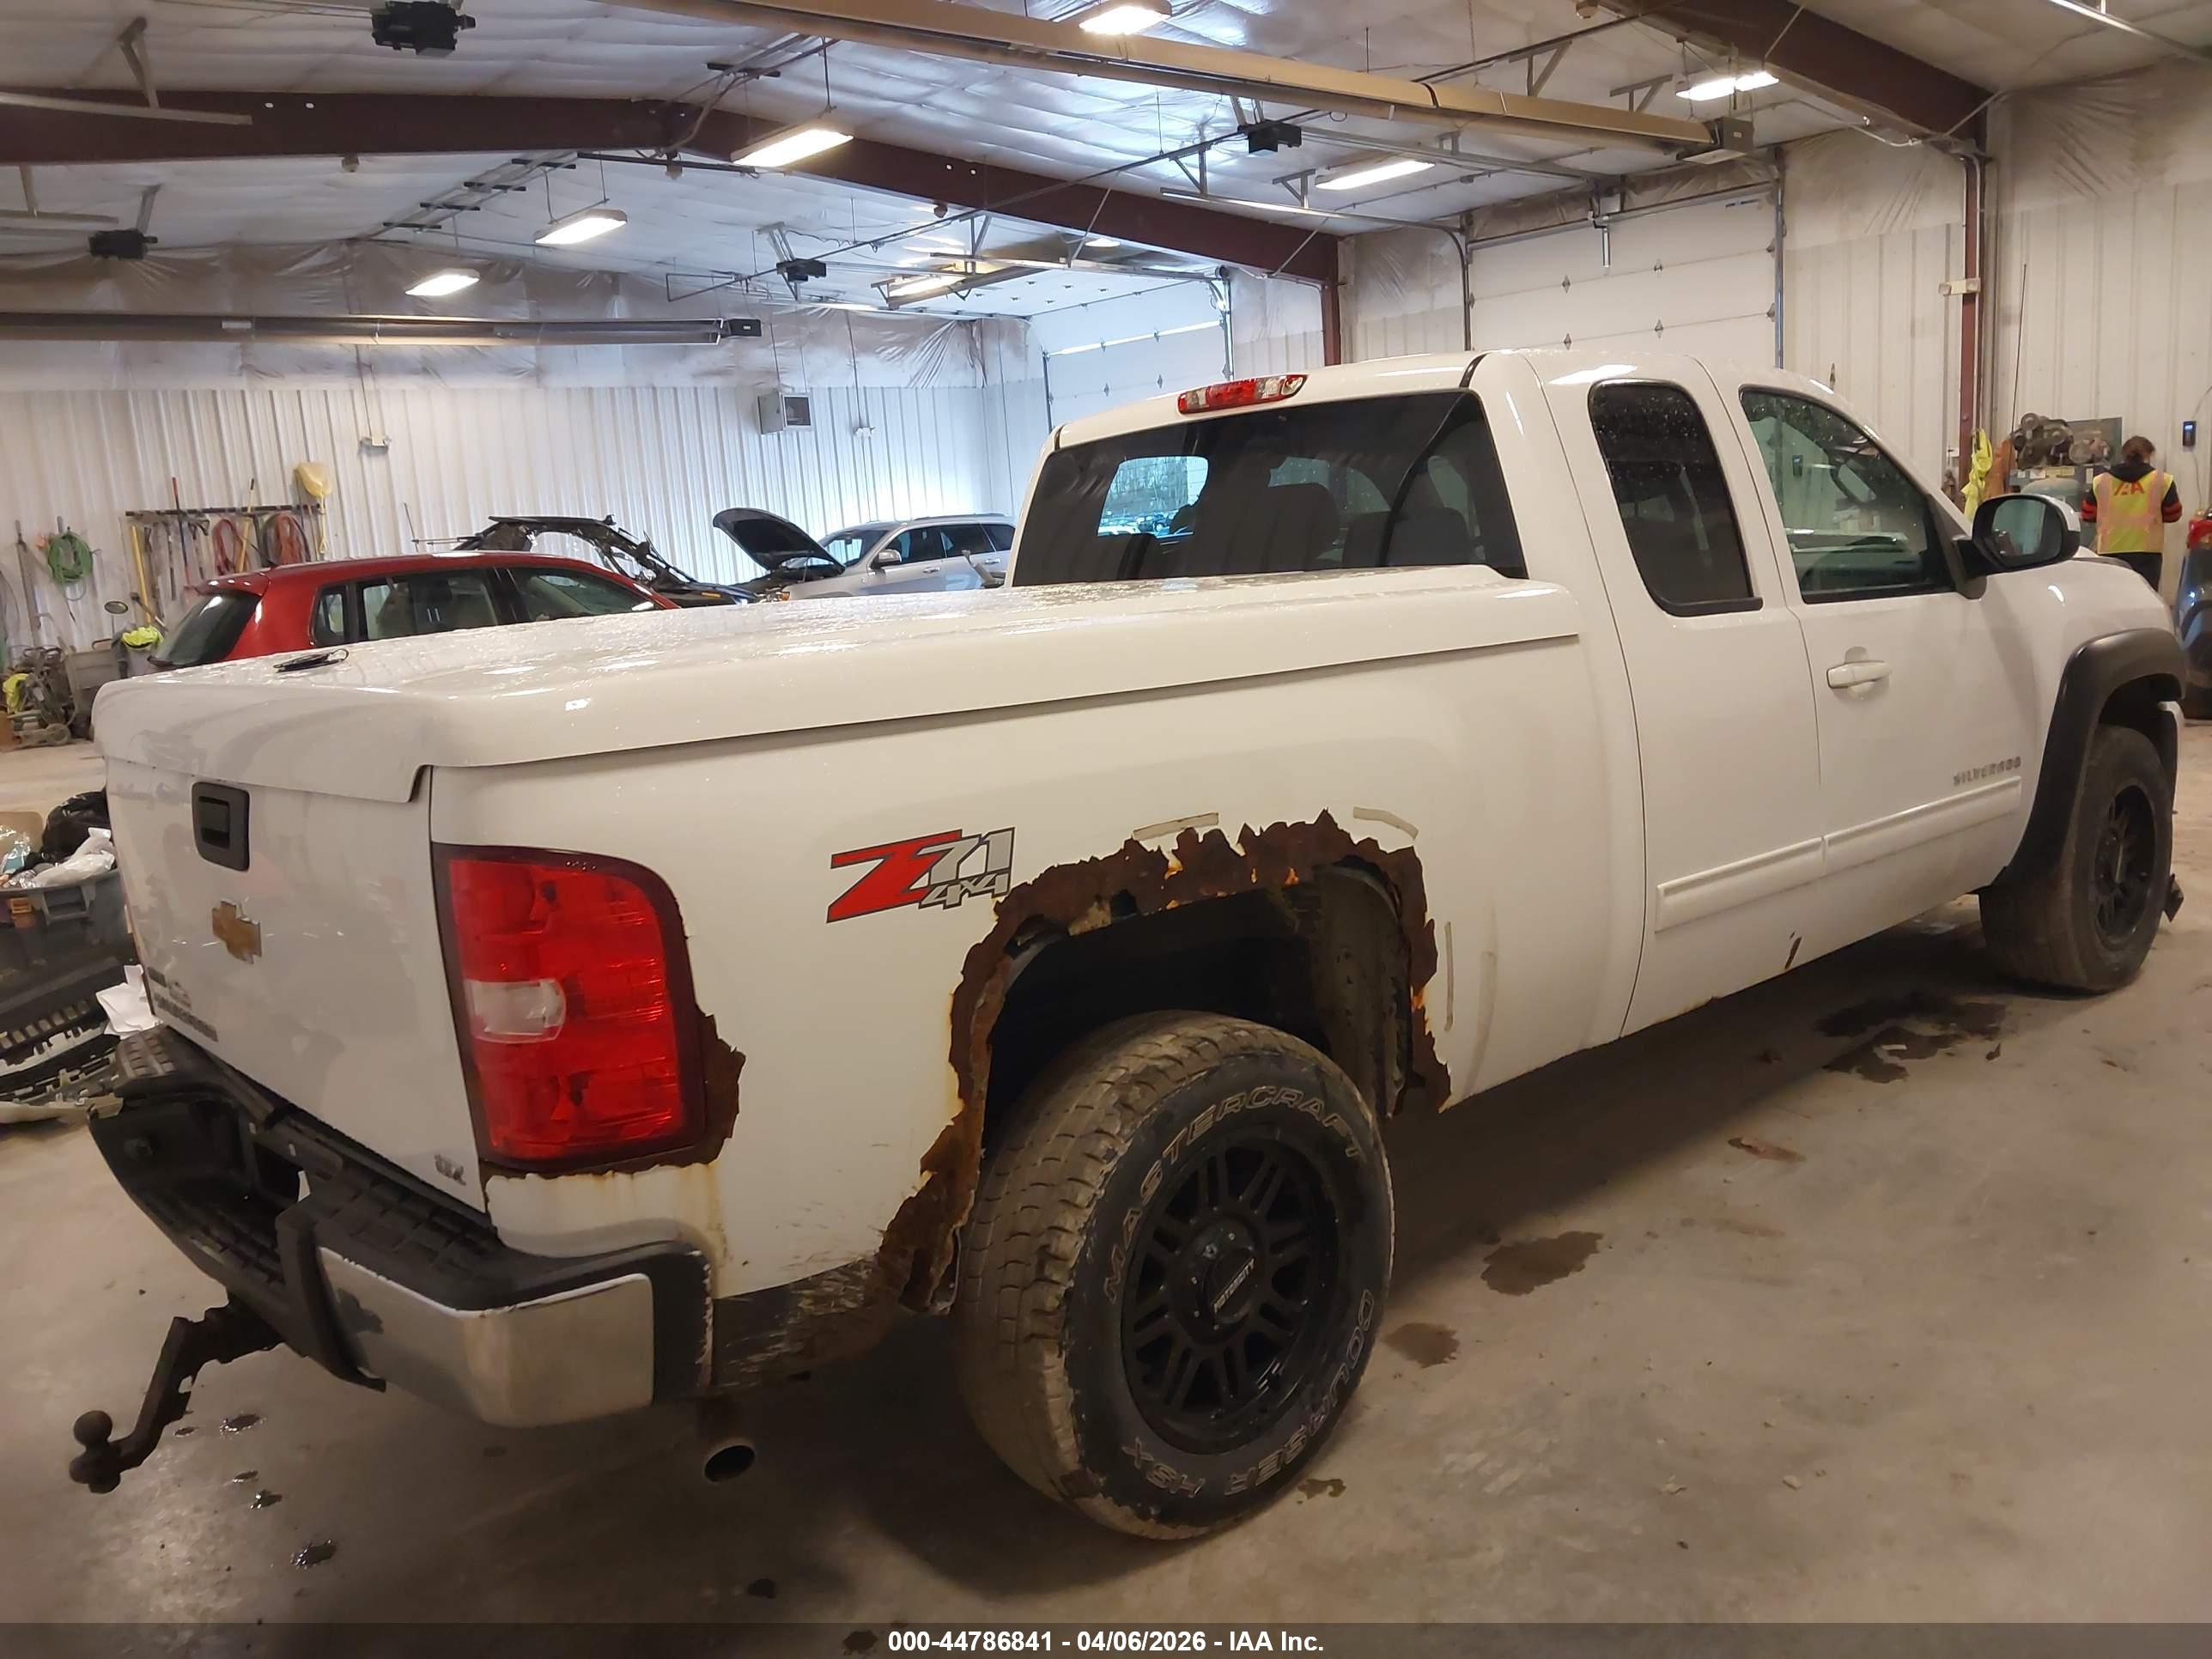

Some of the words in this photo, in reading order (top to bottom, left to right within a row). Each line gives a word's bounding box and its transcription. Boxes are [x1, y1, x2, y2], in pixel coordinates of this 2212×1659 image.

[827, 827, 1016, 923] Z71
[1104, 1085, 1367, 1305] MASTERCRAFT
[1121, 1437, 1206, 1498] HSX
